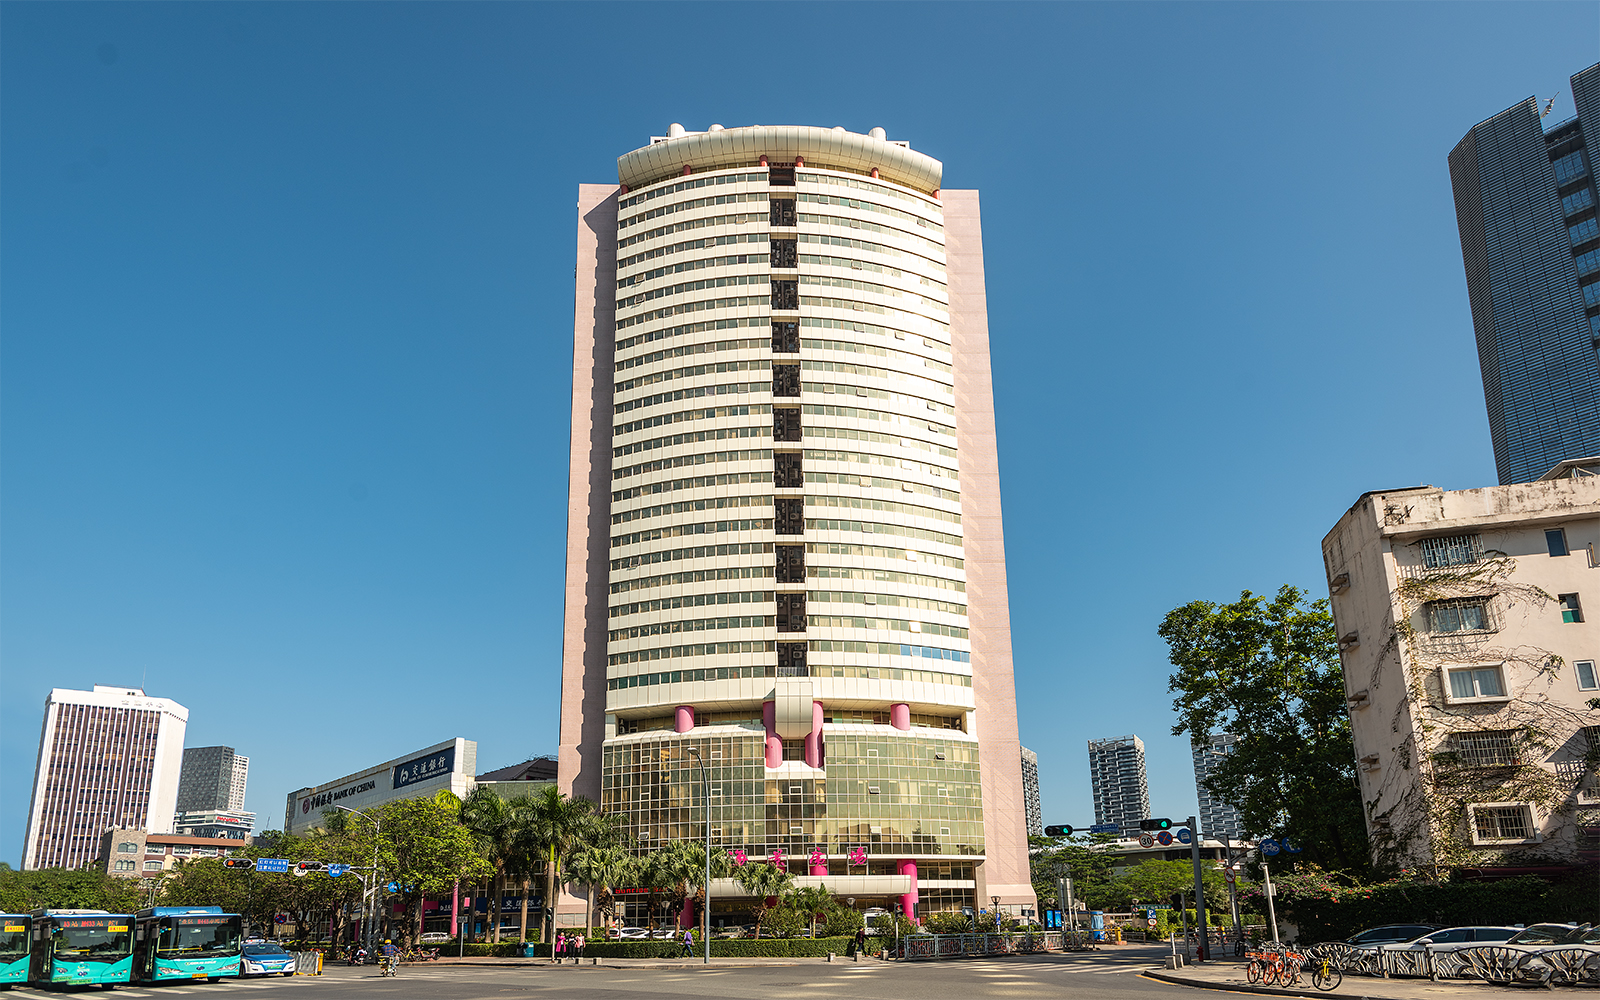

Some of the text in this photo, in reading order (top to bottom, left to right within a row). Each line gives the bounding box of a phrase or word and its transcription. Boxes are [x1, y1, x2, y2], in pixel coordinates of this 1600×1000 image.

[333, 780, 376, 801] BANK OF CHINA
[1141, 836, 1152, 845] 30
